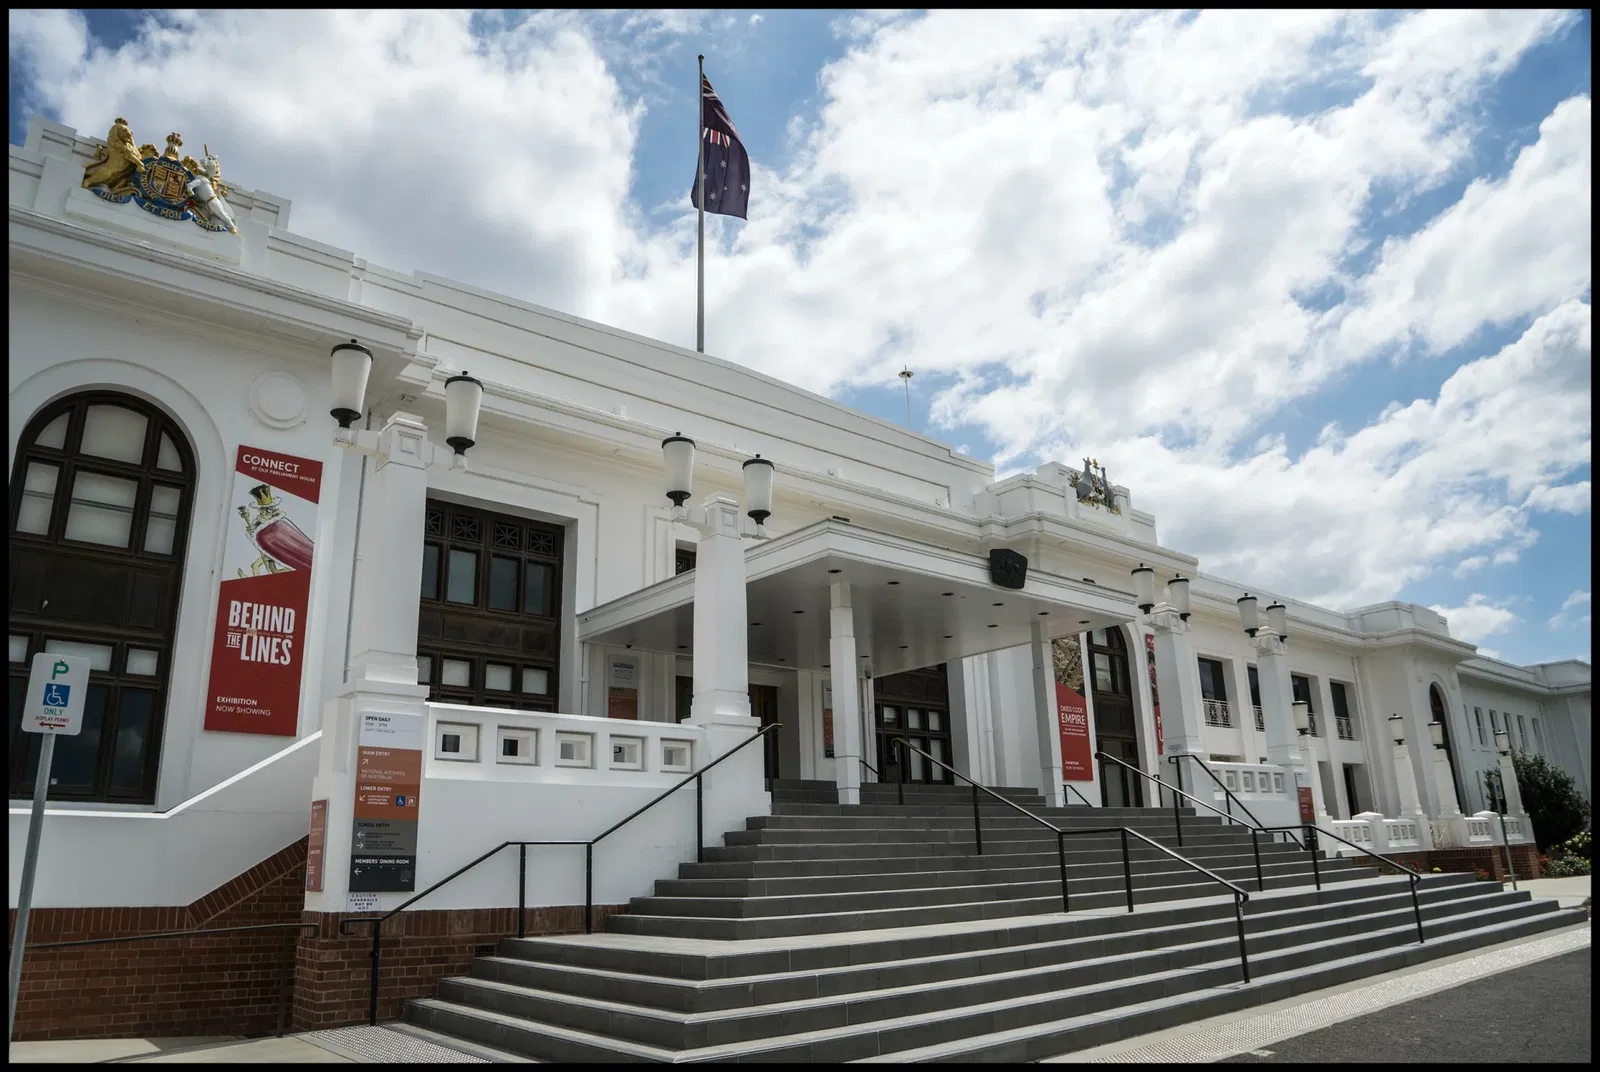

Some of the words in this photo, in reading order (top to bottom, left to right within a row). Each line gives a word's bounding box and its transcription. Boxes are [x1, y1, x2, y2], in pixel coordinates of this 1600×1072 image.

[100, 190, 124, 203] DIEU
[143, 202, 158, 214] ET
[160, 208, 182, 220] MON
[242, 454, 299, 473] CONNECT
[270, 470, 299, 479] PARLIAMENT
[228, 600, 295, 634] BEHIND
[227, 634, 240, 646] THE
[240, 634, 292, 666] LINES
[52, 662, 69, 680] P
[217, 696, 257, 706] EXHIBITION
[44, 707, 64, 716] ONLY
[236, 707, 271, 716] SHOWING
[1061, 713, 1085, 725] EMPIRE
